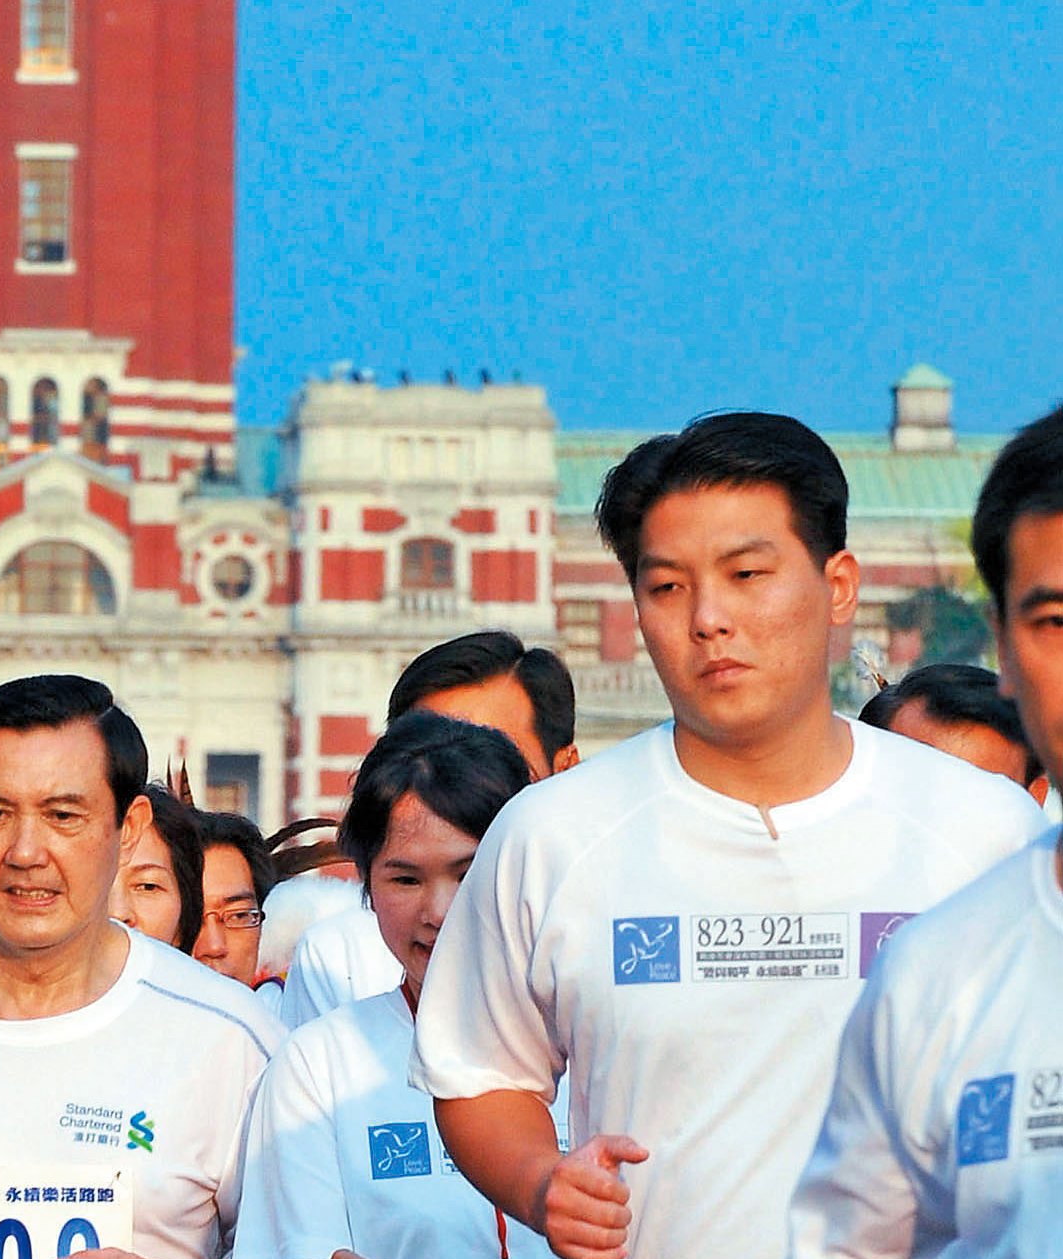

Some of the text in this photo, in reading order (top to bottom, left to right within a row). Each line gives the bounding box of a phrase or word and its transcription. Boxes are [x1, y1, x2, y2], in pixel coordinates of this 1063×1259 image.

[698, 916, 805, 947] 823-921
[65, 1103, 124, 1120] Standard
[59, 1116, 122, 1133] Chartered
[5, 1187, 114, 1203] 永續樂活路跑
